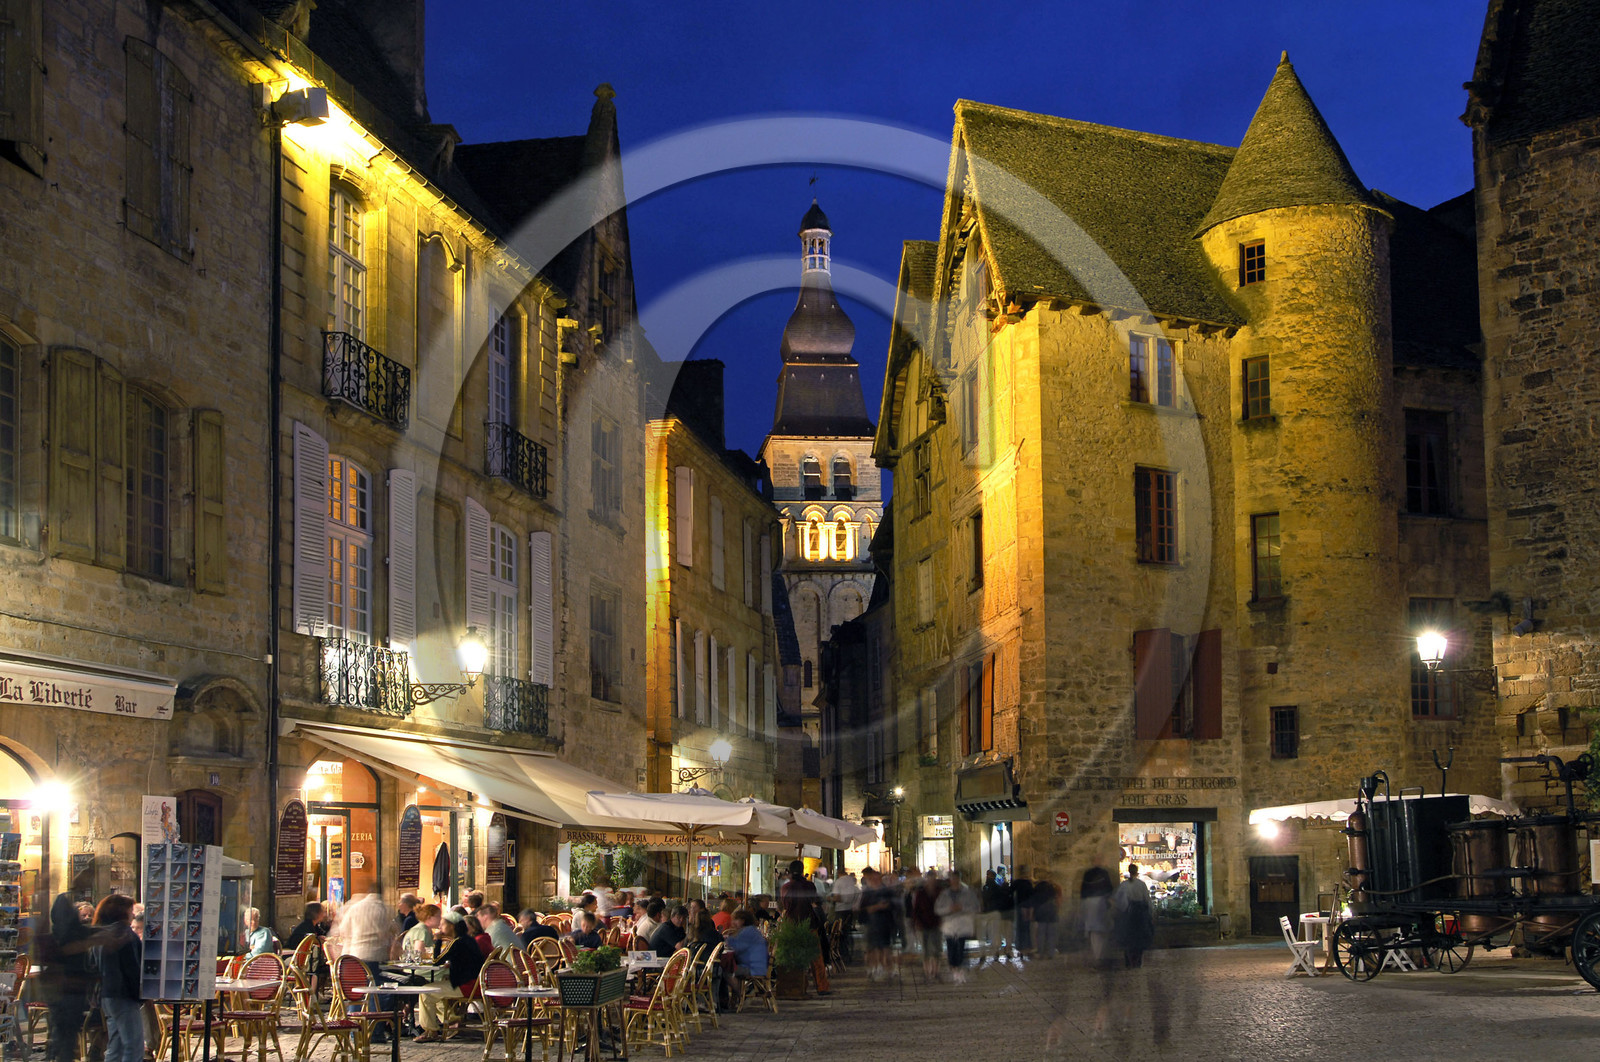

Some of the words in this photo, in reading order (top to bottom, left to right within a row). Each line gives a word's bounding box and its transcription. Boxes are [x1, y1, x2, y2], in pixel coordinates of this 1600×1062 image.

[0, 677, 24, 701] La
[29, 680, 93, 709] Liberté
[114, 695, 137, 714] Bar
[210, 775, 219, 785] 10
[1152, 777, 1169, 789] DU
[1176, 777, 1237, 789] PERIGORD
[1121, 794, 1149, 806] FOIE
[1156, 793, 1188, 806] GRAS
[567, 831, 607, 842] BRASSERIE
[616, 833, 647, 843] PIZZERIA
[664, 834, 674, 843] Le
